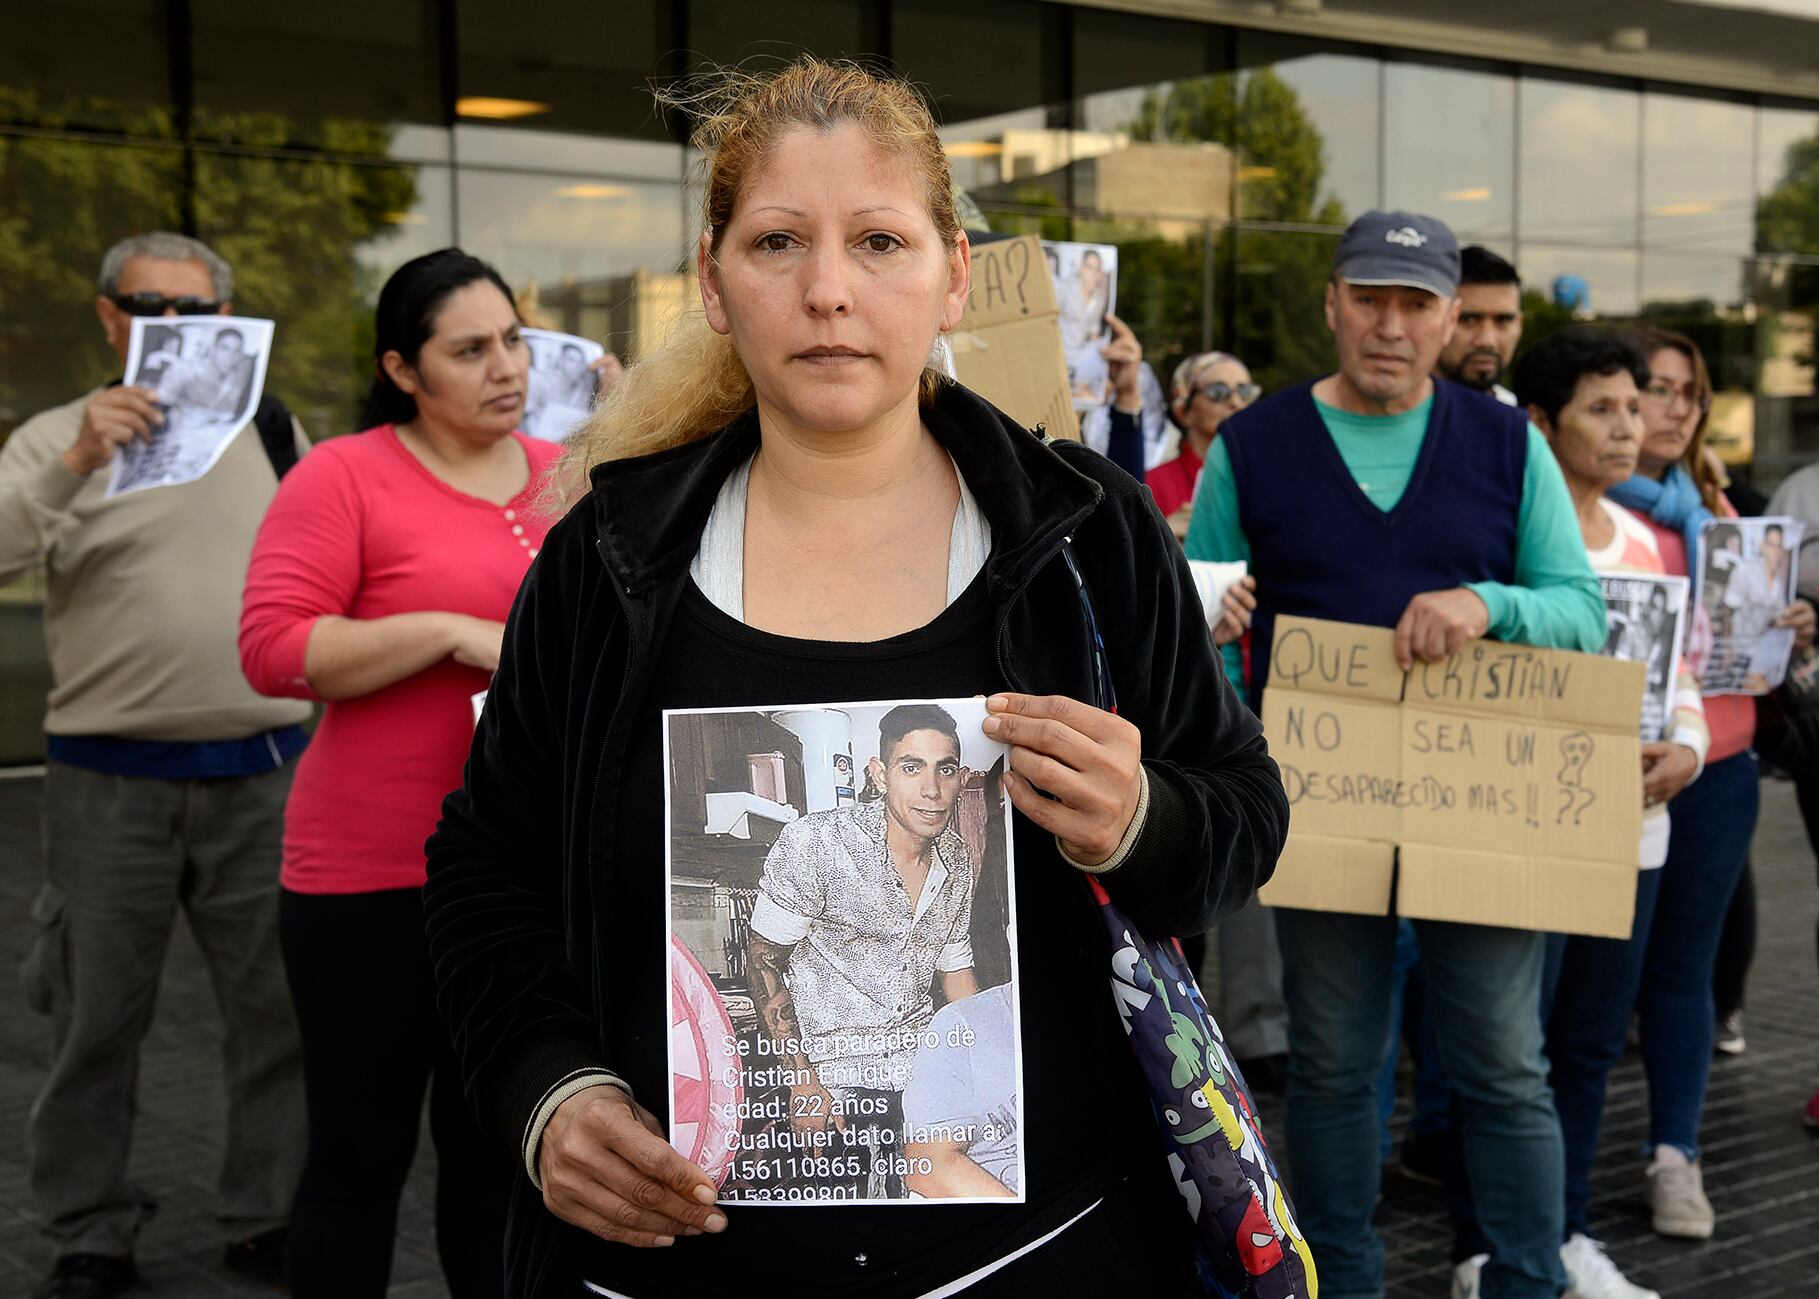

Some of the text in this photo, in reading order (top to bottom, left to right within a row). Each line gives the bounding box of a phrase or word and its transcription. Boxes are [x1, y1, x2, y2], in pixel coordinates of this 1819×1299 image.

[1274, 627, 1369, 688] QUE
[1285, 706, 1537, 767] NO SEA UN
[721, 1024, 976, 1057] Se busca paradero de
[722, 1065, 811, 1088] Cristian
[722, 1091, 888, 1119] edad: 22 años
[724, 1126, 836, 1153] Cualquier
[842, 1123, 895, 1147] dato
[902, 1121, 976, 1144] llamar
[726, 1152, 933, 1181] 156110865. claro
